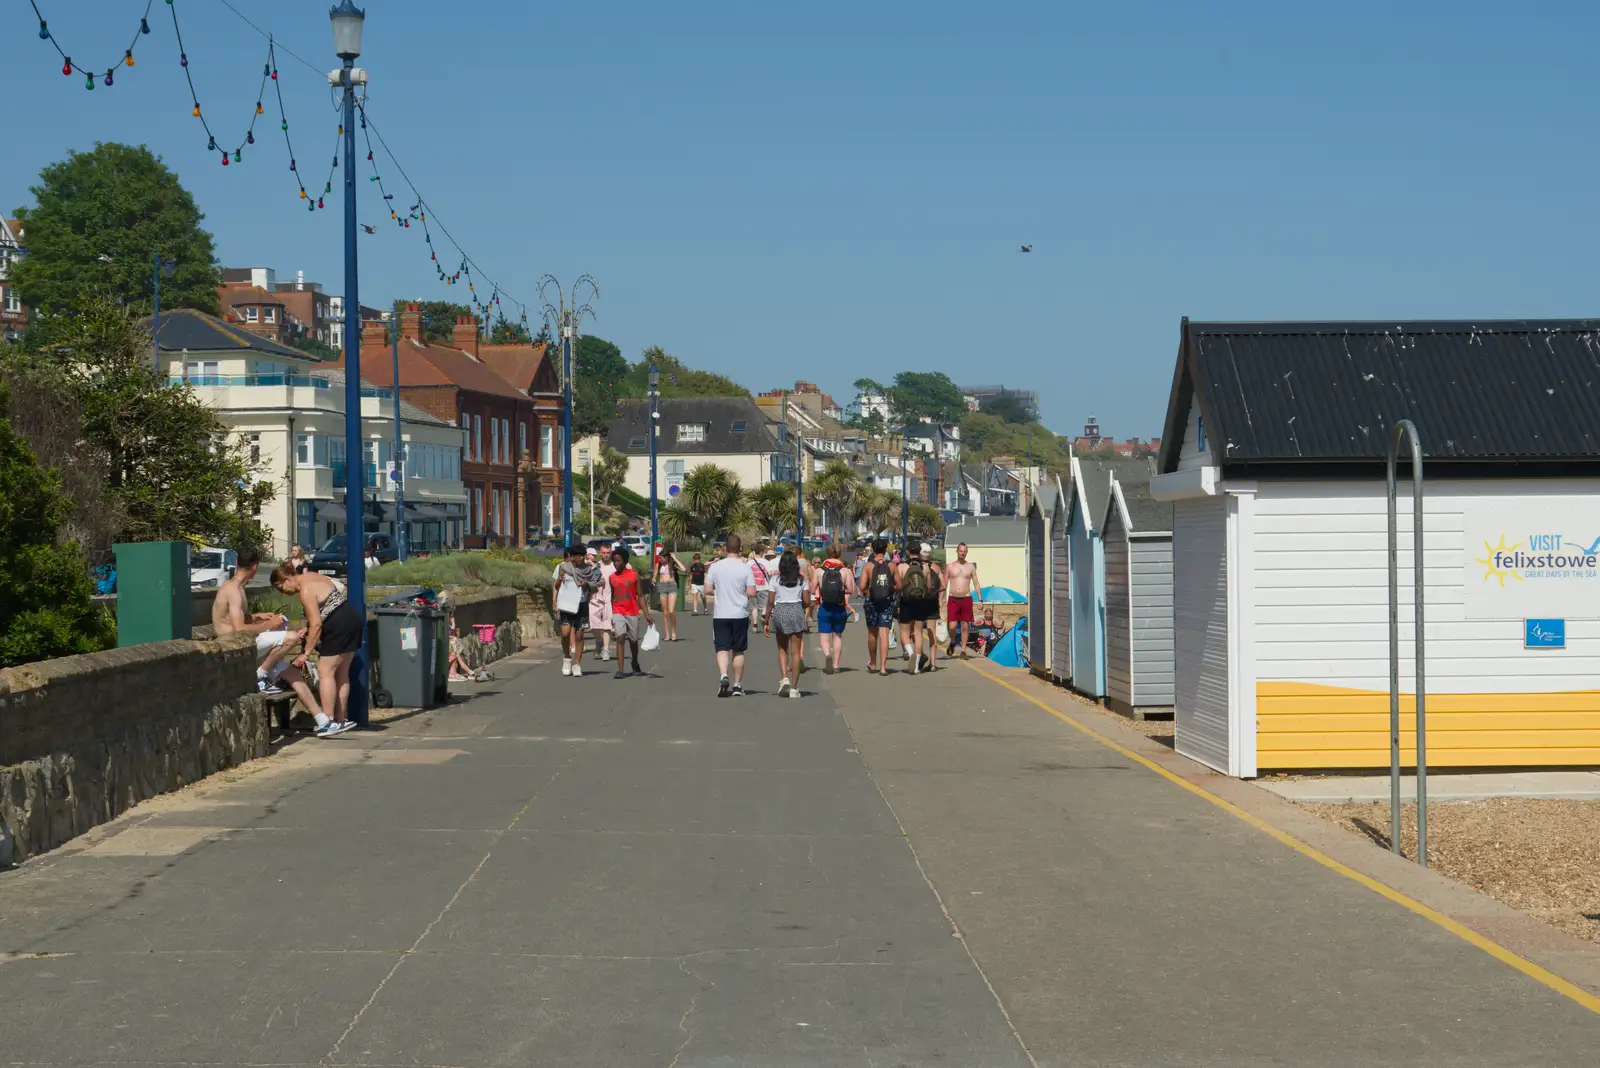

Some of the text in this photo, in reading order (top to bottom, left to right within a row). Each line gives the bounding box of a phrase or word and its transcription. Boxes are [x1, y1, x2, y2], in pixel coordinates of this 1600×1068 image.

[1529, 534, 1562, 551] VISIT
[1494, 551, 1597, 568] felixstowe
[1525, 570, 1597, 578] GREAT DAYS BY THE SEA
